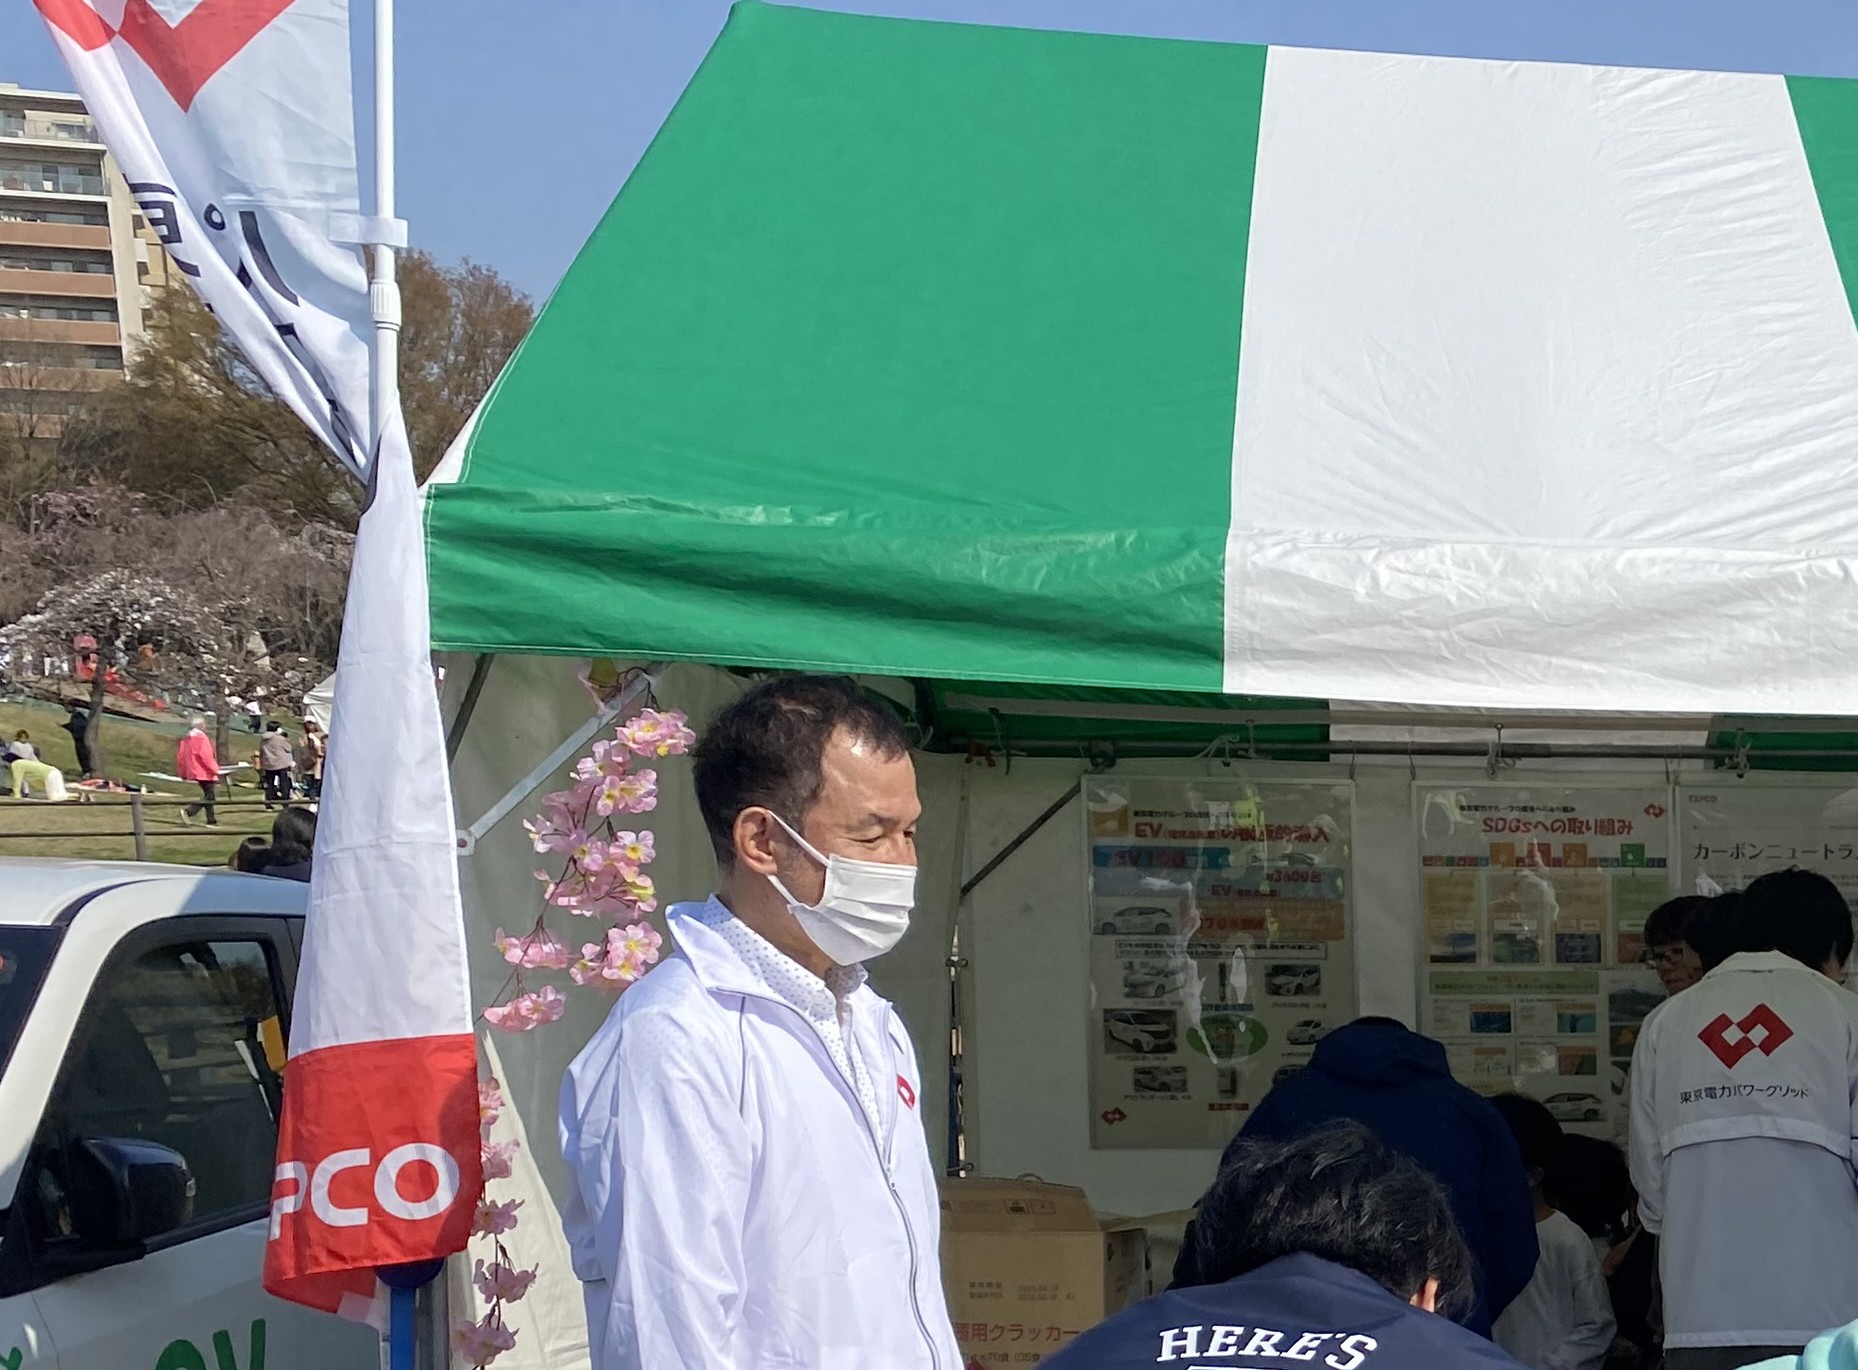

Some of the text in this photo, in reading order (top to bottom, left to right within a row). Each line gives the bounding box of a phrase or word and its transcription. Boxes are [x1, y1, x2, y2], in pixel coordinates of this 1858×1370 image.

[1482, 817, 1634, 836] SDGsへの取り組み
[1680, 1084, 1809, 1105] 東京電力パワーグリッド
[1156, 1325, 1378, 1370] HERE'S
